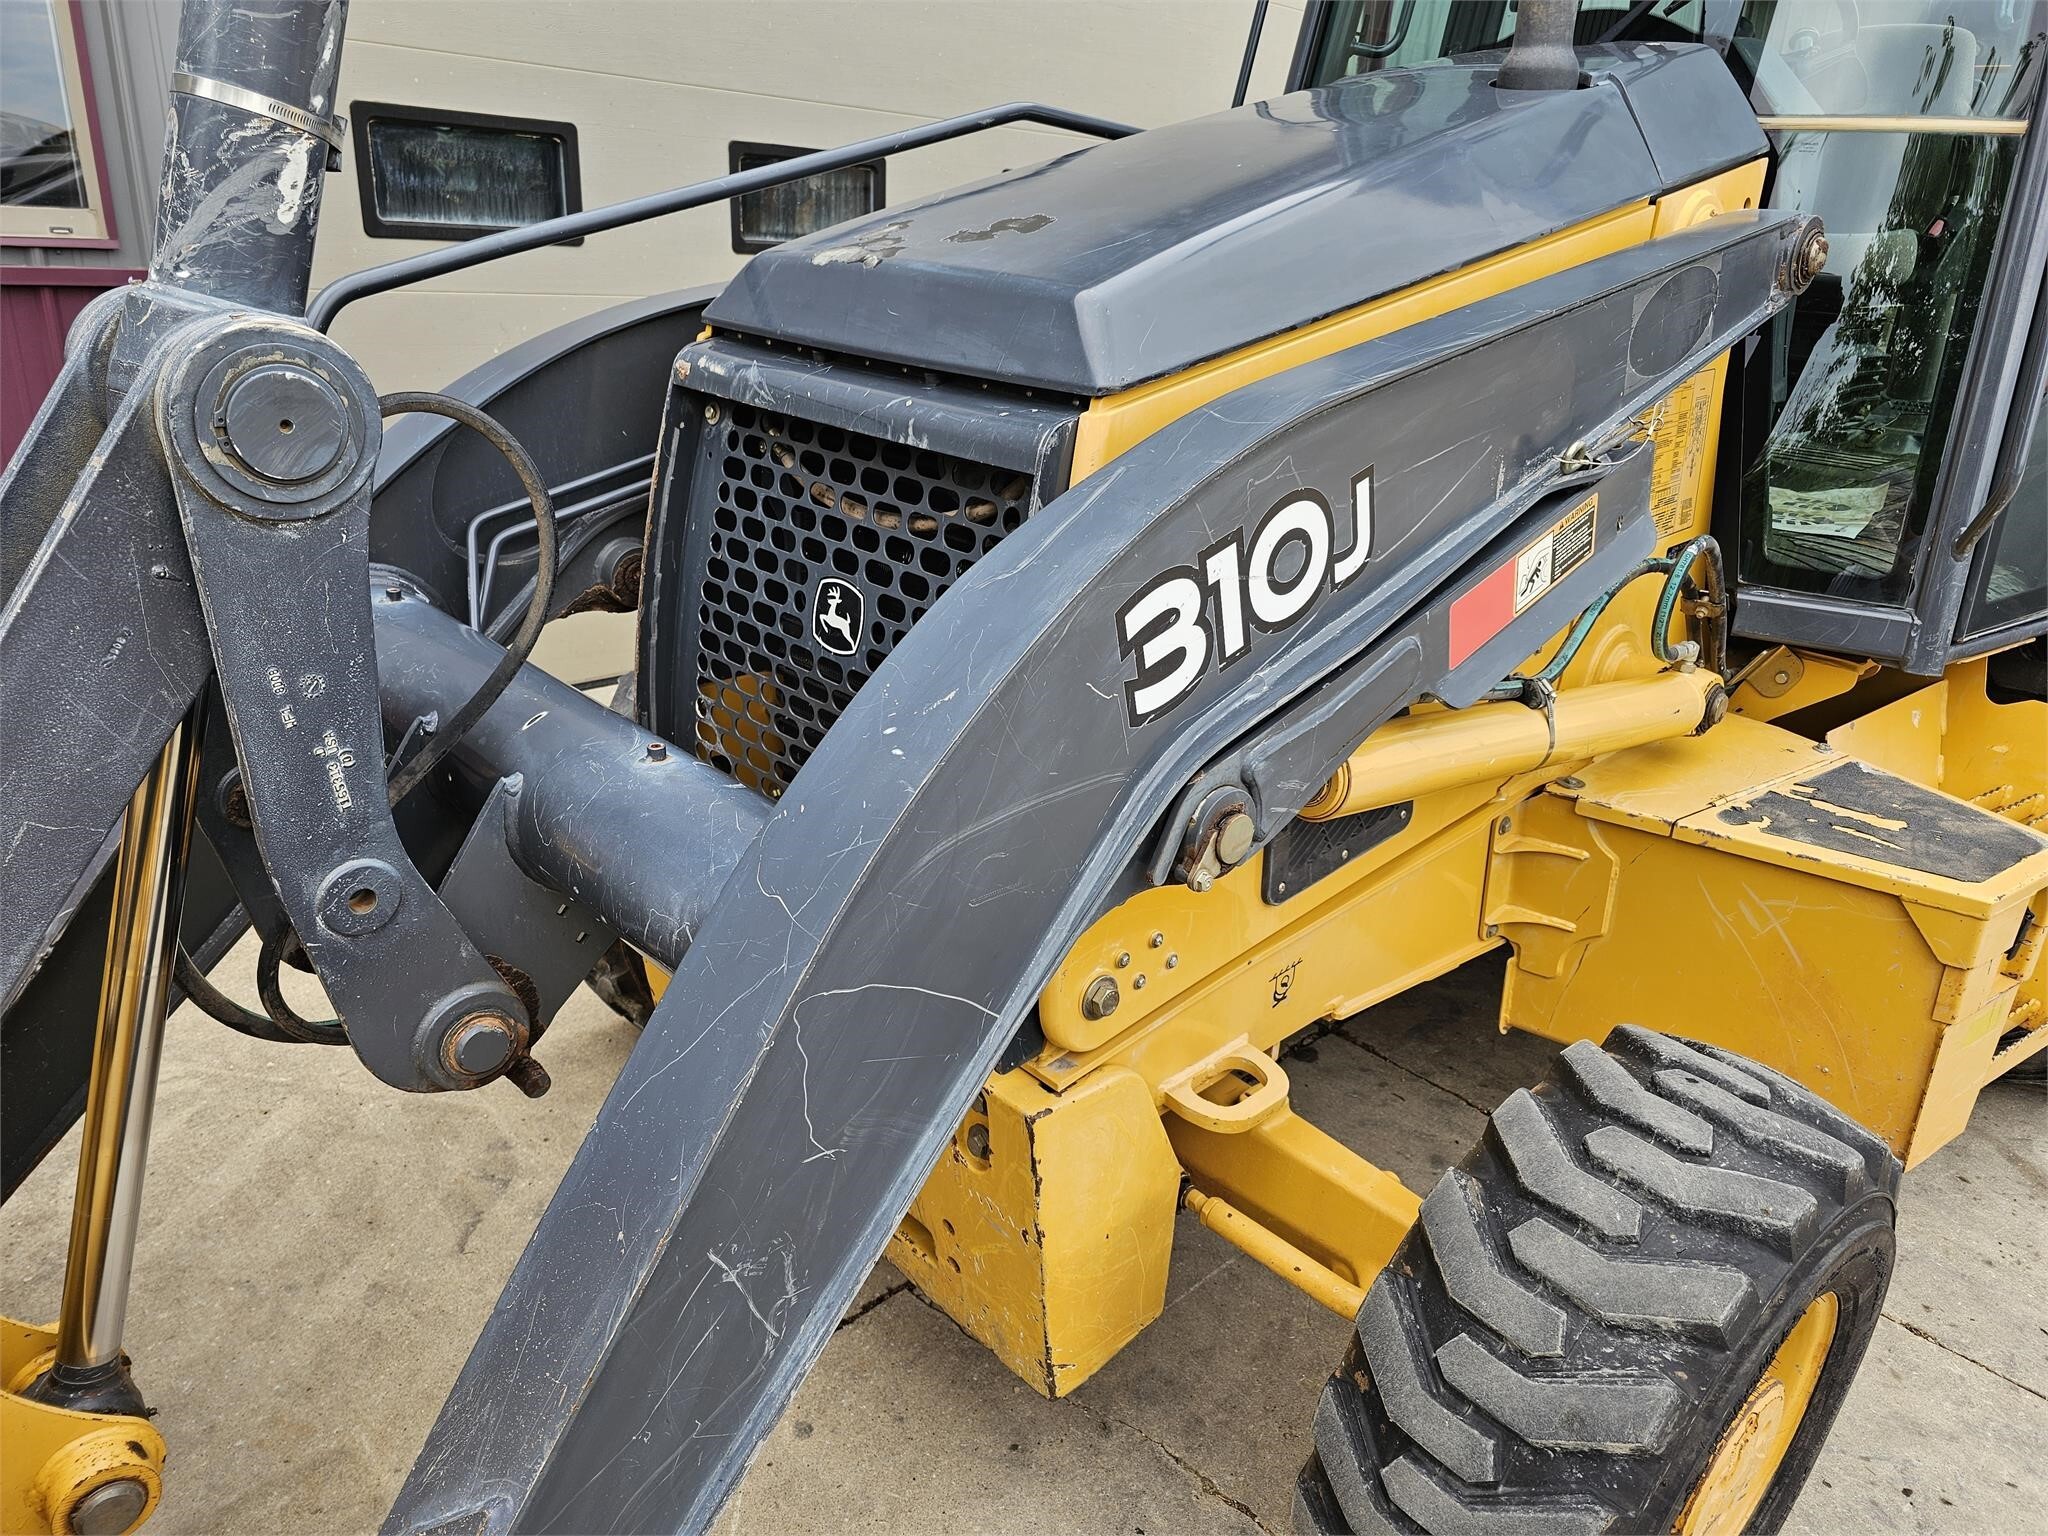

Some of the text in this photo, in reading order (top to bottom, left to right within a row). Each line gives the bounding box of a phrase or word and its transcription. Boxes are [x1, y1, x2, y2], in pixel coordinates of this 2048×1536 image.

[1565, 498, 1593, 524] WARNING
[1116, 465, 1375, 726] 310J
[323, 730, 341, 757] USA
